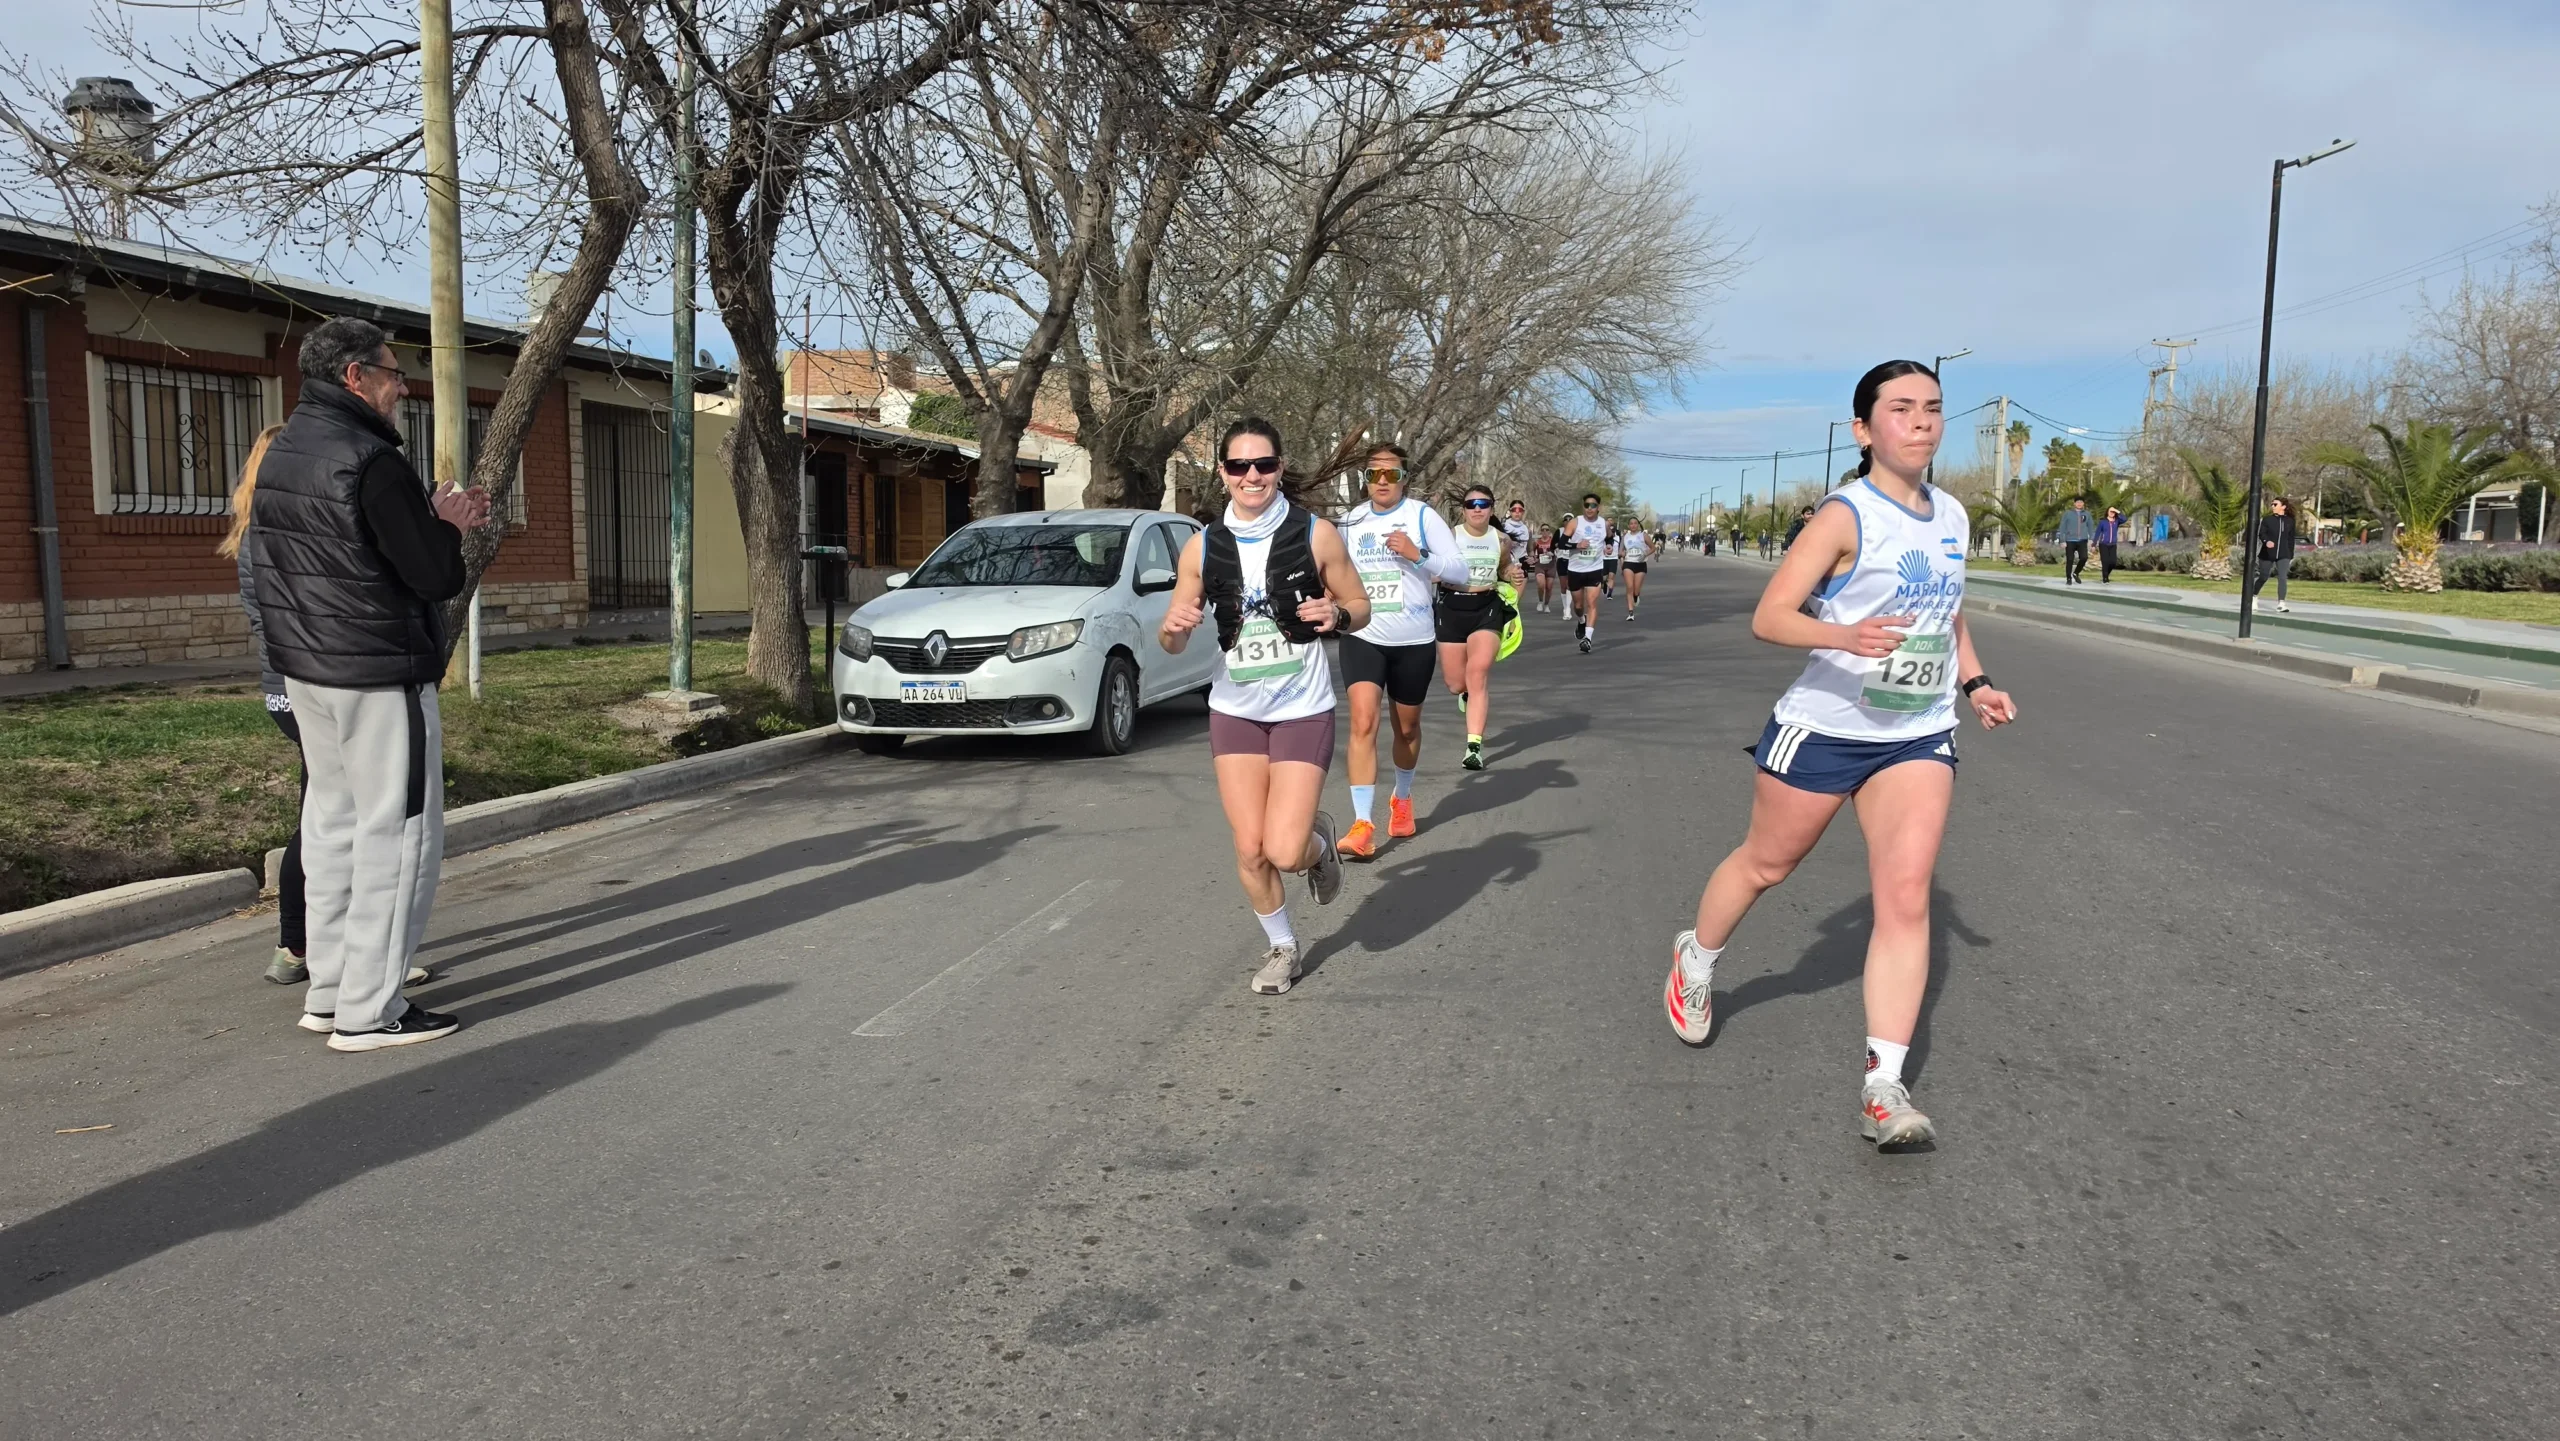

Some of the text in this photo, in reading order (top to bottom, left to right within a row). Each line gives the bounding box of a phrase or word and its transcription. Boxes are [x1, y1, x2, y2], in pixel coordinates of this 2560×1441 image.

[1470, 566, 1494, 577] 127
[1366, 584, 1398, 599] 287
[1251, 623, 1272, 634] 10K
[1232, 638, 1294, 662] 1311
[1914, 640, 1935, 651] 10K
[1877, 657, 1944, 686] 1281
[904, 688, 963, 700] AA 264 VU
